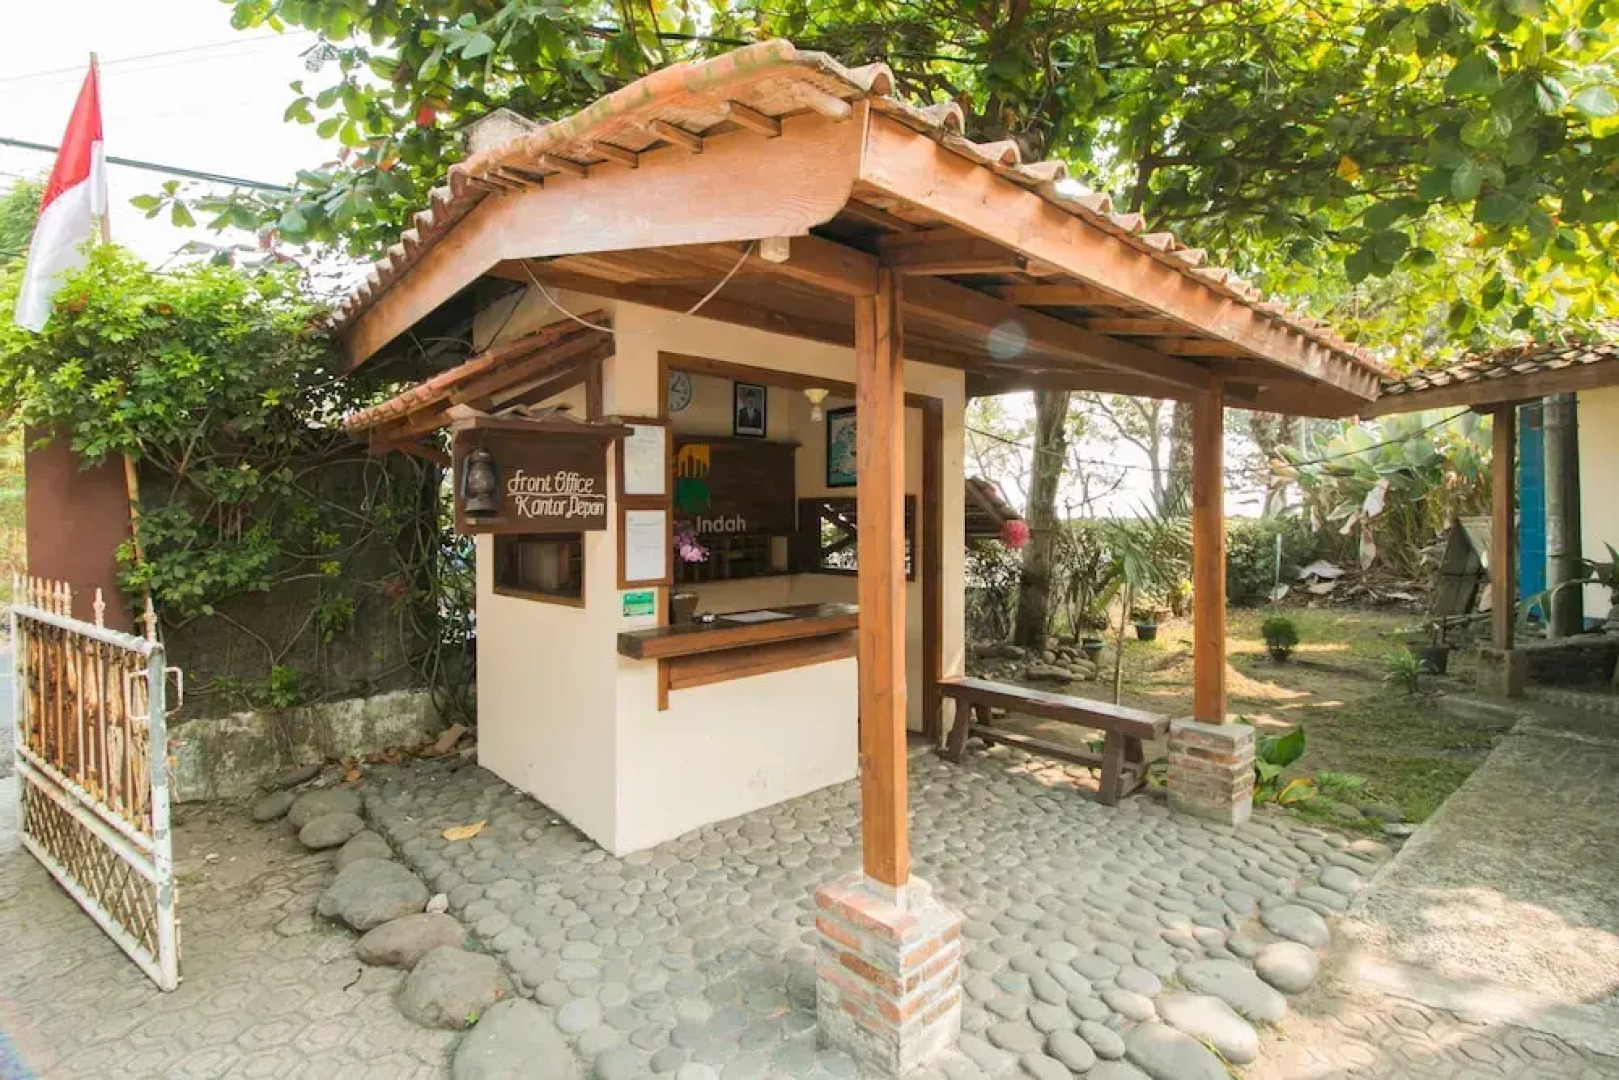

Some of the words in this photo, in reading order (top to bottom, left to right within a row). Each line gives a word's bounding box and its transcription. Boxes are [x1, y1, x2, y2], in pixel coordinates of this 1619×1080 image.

[554, 470, 595, 493] Office
[514, 495, 567, 518] Kantor
[565, 496, 605, 518] Depan
[696, 514, 746, 533] Indah
